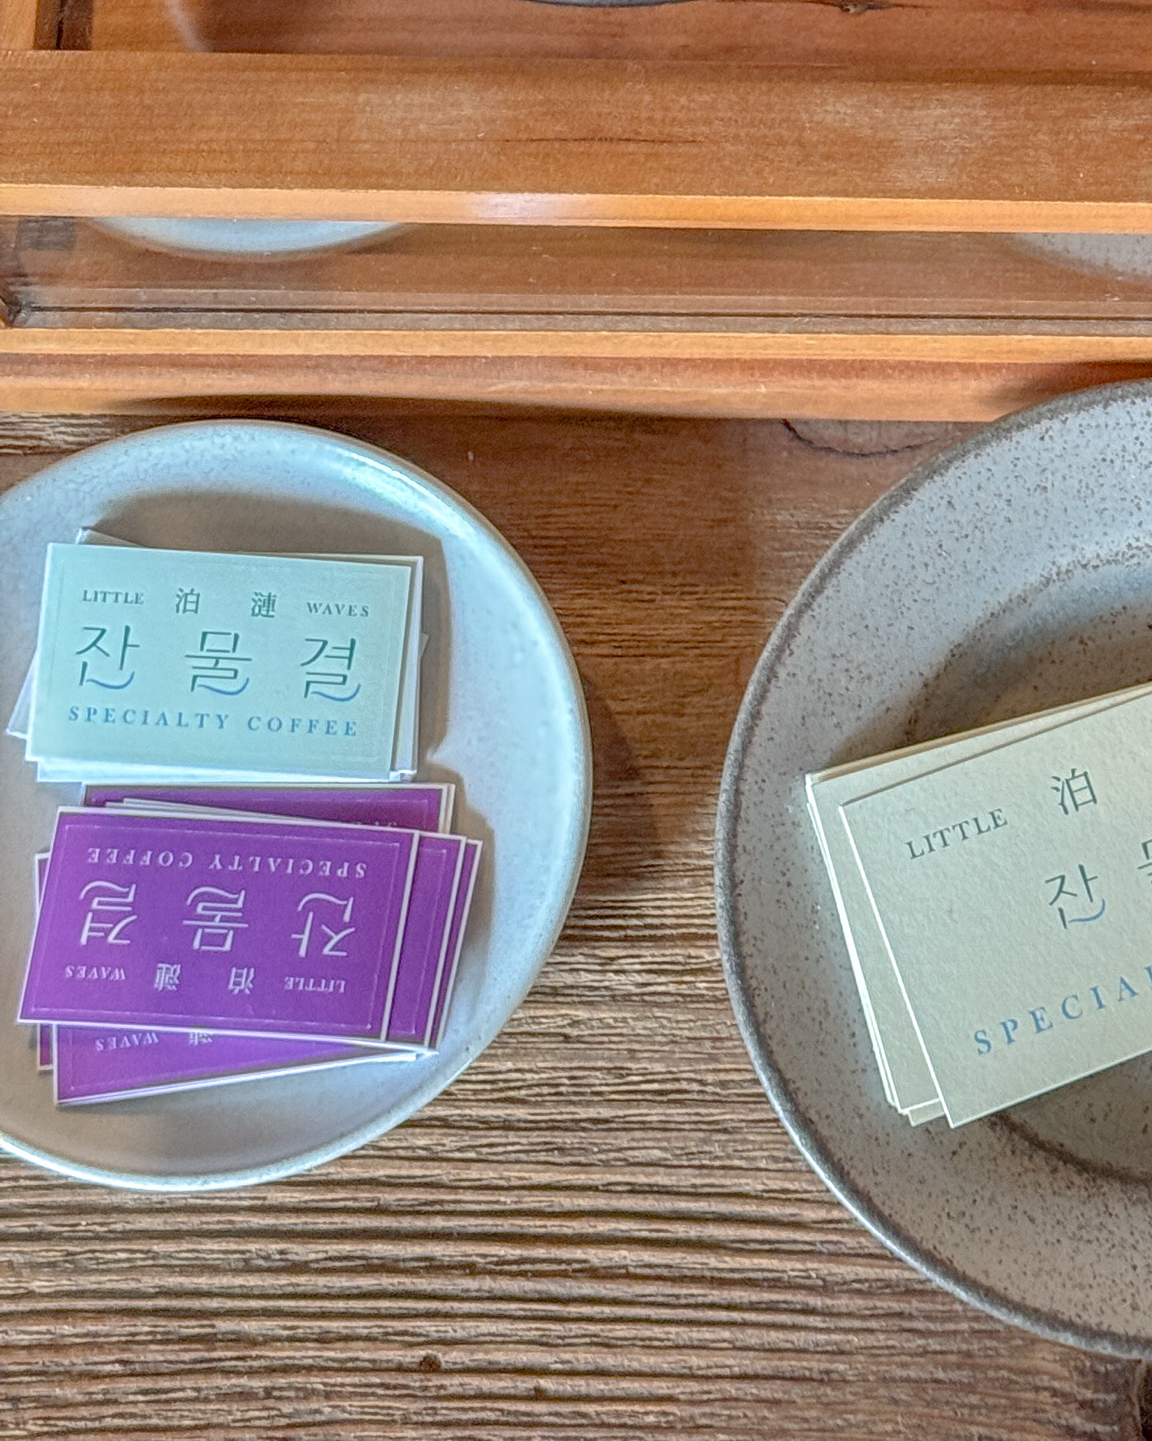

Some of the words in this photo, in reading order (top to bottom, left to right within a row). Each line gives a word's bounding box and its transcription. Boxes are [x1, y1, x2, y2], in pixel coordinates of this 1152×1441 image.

[82, 589, 144, 605] LITTLE
[306, 601, 370, 618] WAVES
[68, 705, 230, 730] SPECIALTY
[247, 716, 358, 736] COFFEE
[905, 807, 1009, 860] LITTLE
[87, 847, 193, 868] COFFEE
[208, 854, 367, 878] SPECIALTY
[65, 965, 126, 980] WAVES
[284, 976, 346, 993] LITTLE
[95, 1031, 160, 1051] WAVES
